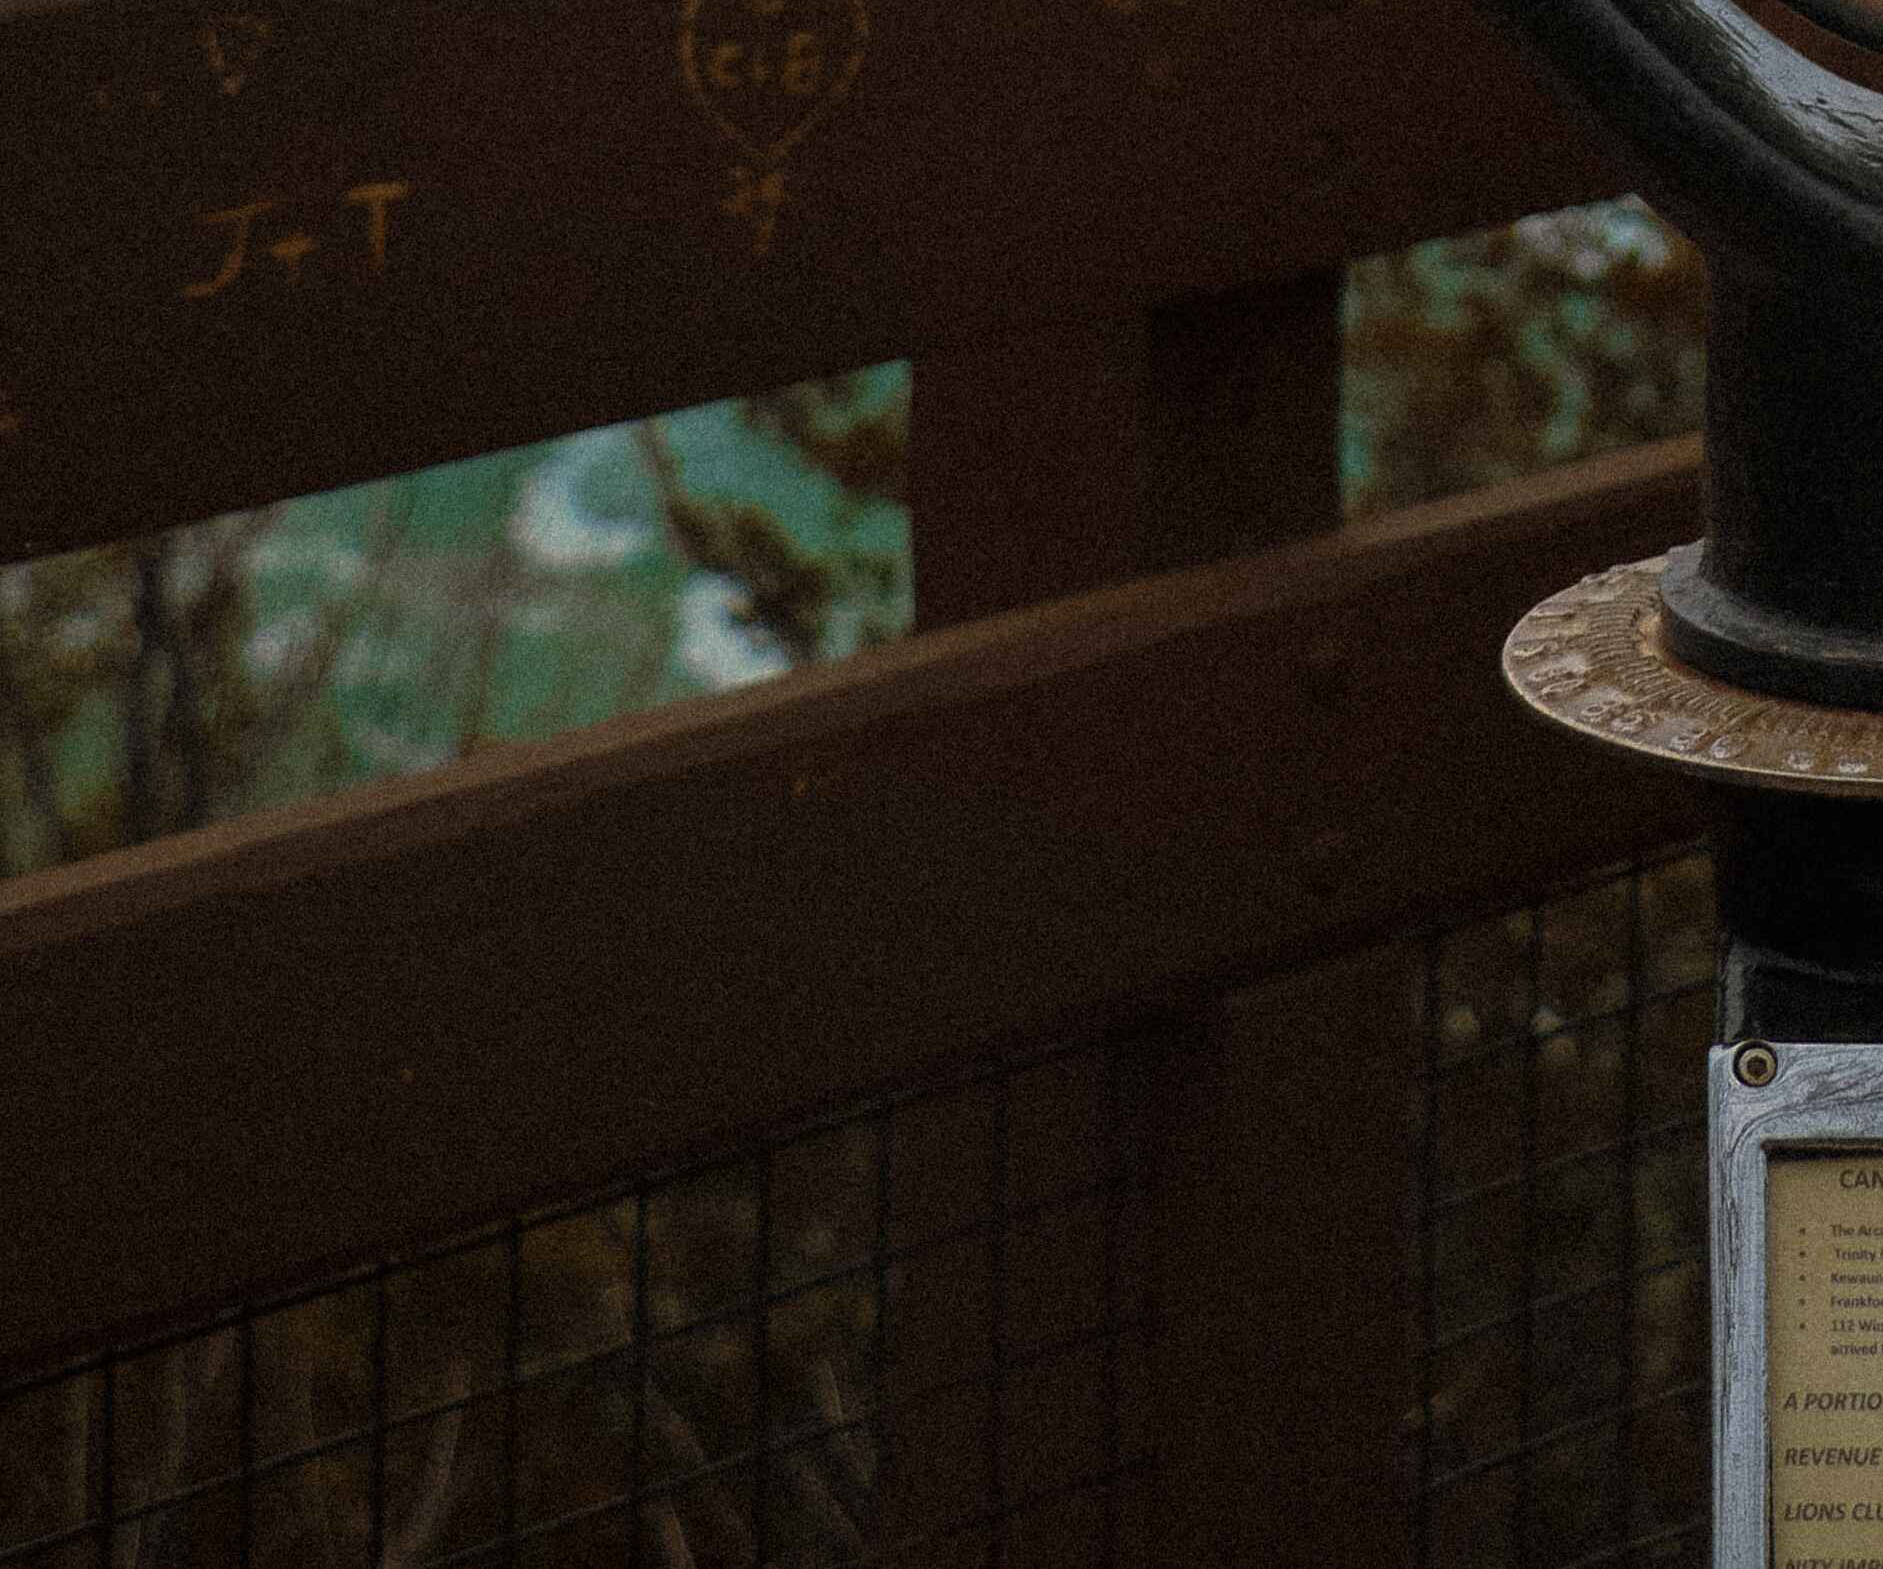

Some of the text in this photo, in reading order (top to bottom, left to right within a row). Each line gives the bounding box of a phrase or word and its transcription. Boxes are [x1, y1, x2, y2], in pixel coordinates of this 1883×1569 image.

[1831, 1225, 1855, 1238] The
[1834, 1248, 1876, 1262] Trinity
[1830, 1342, 1877, 1356] arrived
[1783, 1392, 1798, 1411] A
[1784, 1447, 1883, 1467] REVENUE
[1784, 1503, 1846, 1522] LIONS
